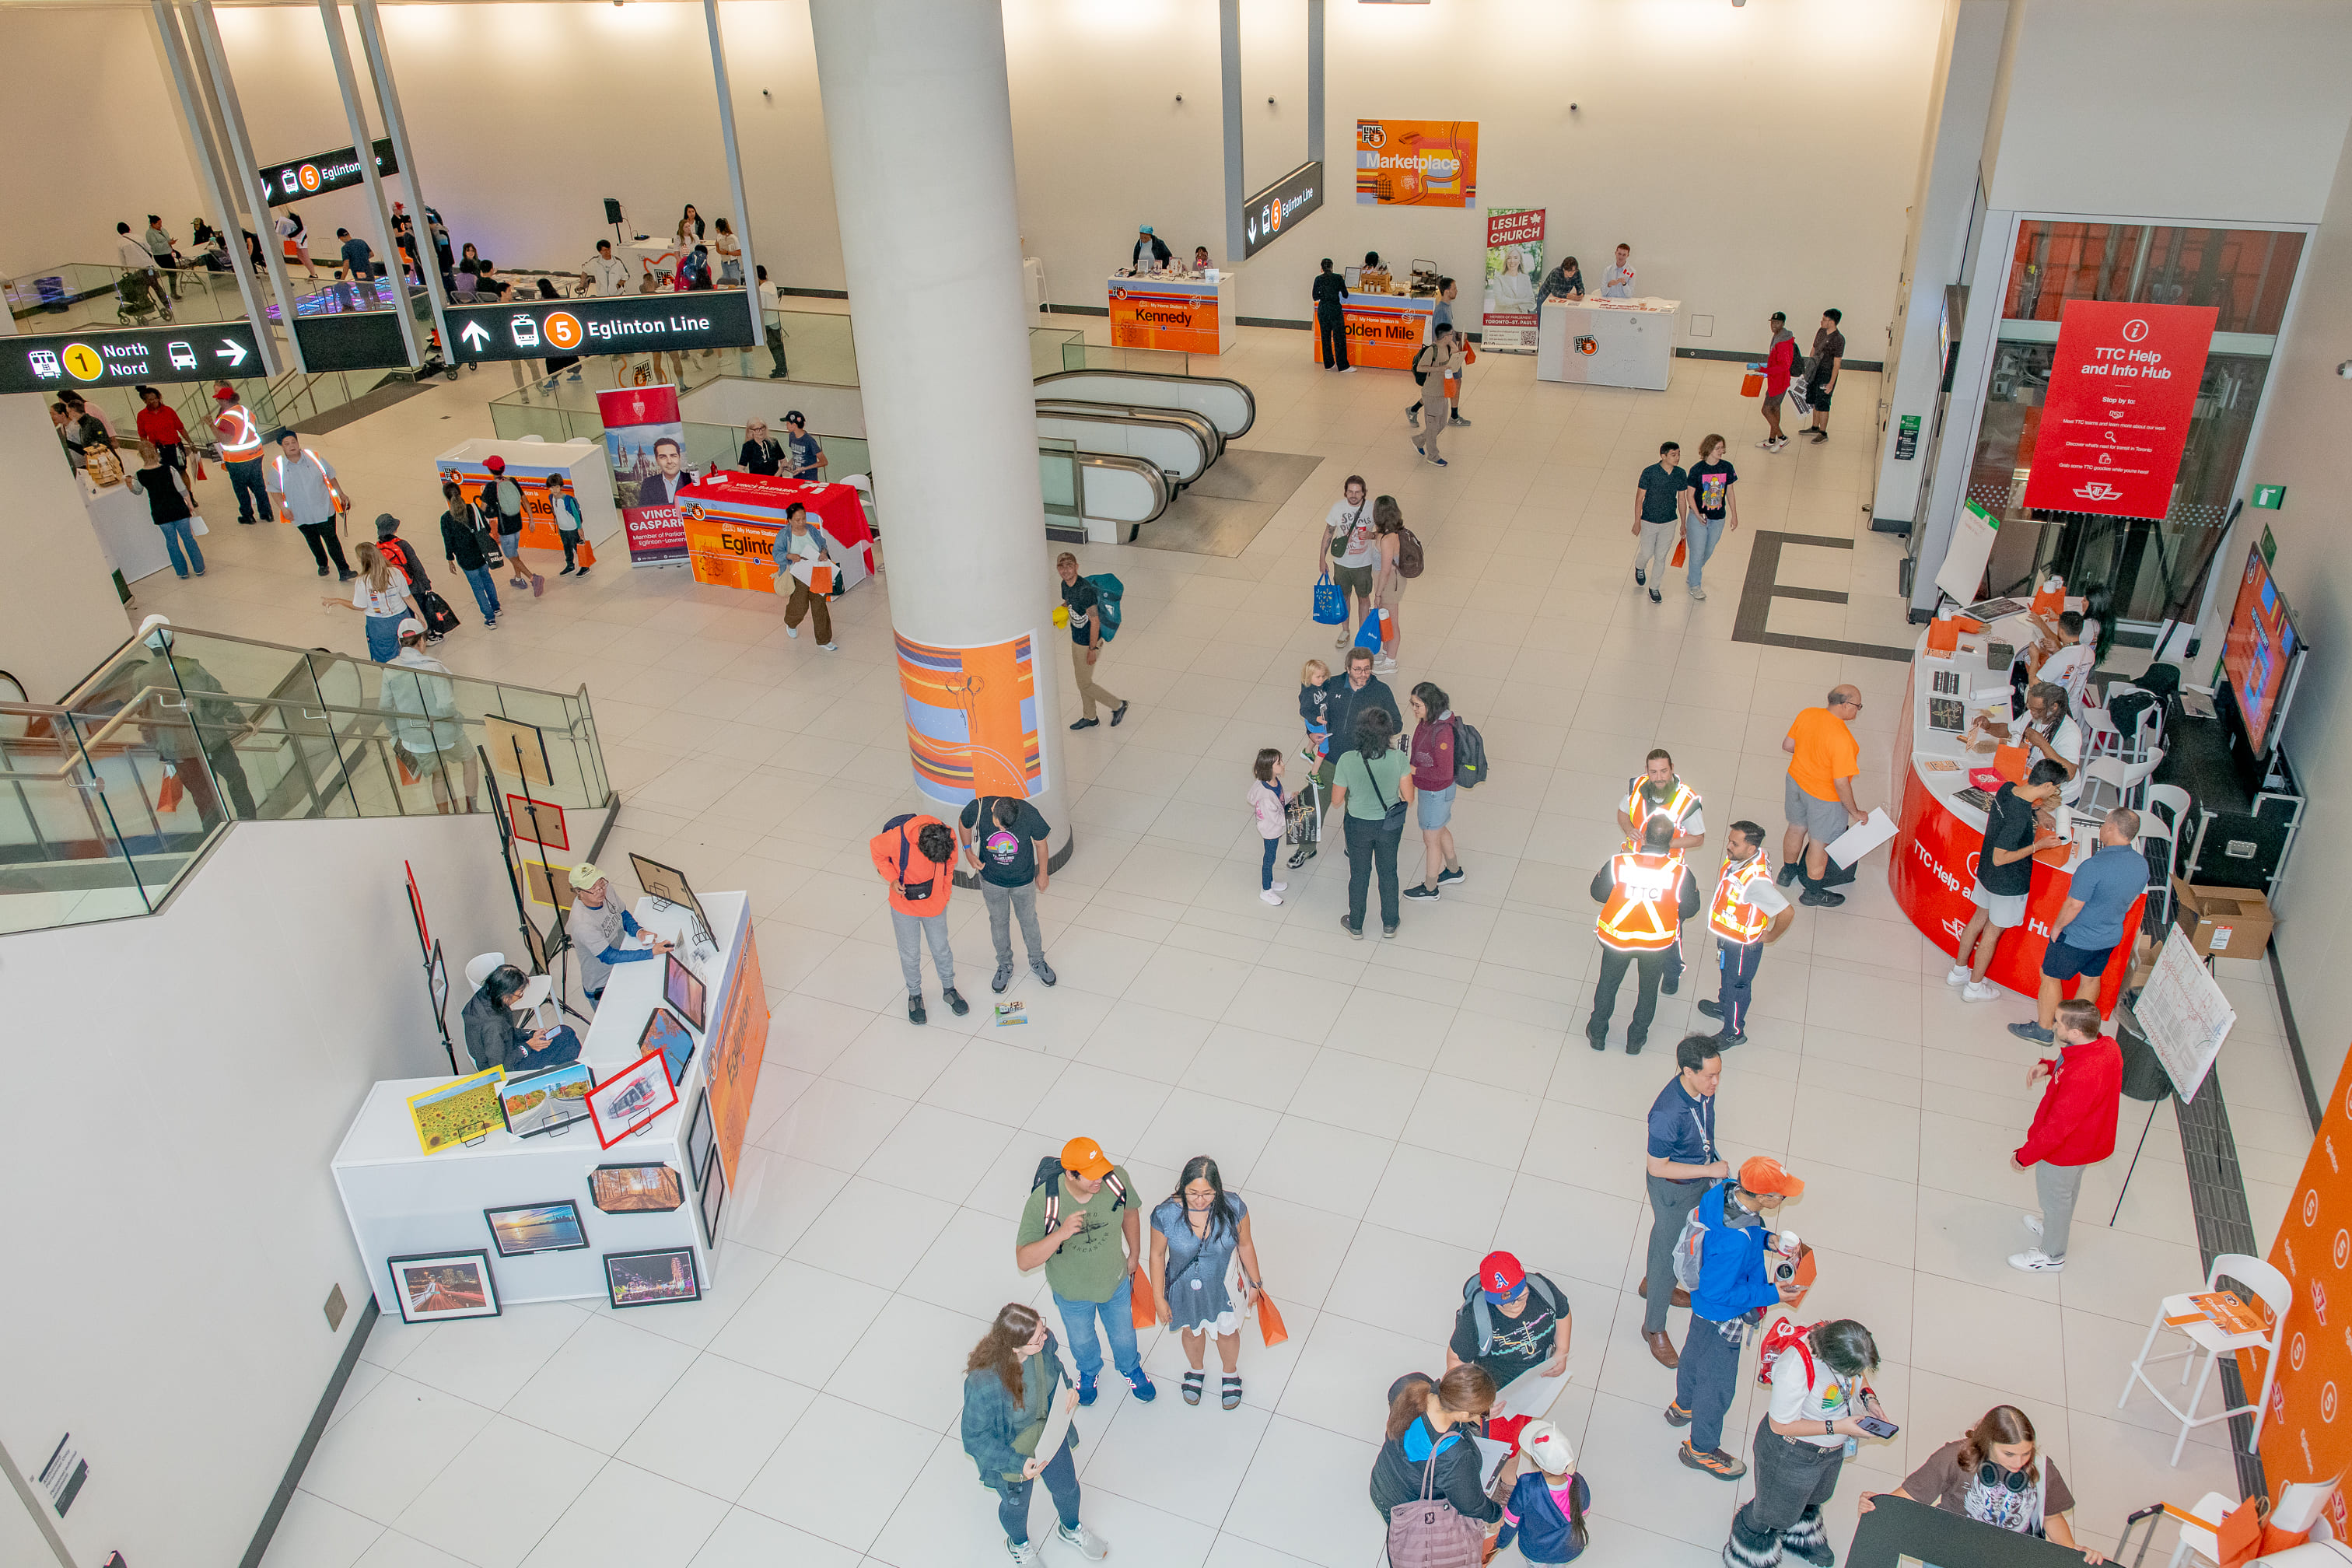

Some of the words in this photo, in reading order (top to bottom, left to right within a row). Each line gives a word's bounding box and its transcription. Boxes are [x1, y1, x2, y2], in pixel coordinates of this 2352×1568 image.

[1366, 152, 1460, 173] Marketplace
[304, 170, 315, 185] 5
[321, 162, 361, 181] Eglinton
[1274, 207, 1279, 224] 5
[1282, 194, 1302, 218] Eglinton
[1303, 187, 1313, 202] Line
[1492, 215, 1528, 230] LESLIE
[1490, 226, 1541, 243] CHURCH
[1136, 309, 1192, 327] Kennedy
[556, 321, 572, 341] 5
[587, 317, 669, 341] Eglinton
[671, 316, 710, 333] Line
[1344, 323, 1381, 338] olden
[1386, 325, 1414, 340] Mile
[75, 353, 89, 372] 1
[102, 342, 149, 359] North
[2095, 347, 2125, 361] TTC
[2128, 350, 2161, 365] Help
[108, 362, 149, 376] Nord
[2081, 363, 2109, 375] and
[2111, 364, 2138, 377] Info
[2141, 366, 2171, 380] Hub
[642, 508, 677, 520] VINCE
[1914, 838, 1933, 868] TTC
[1933, 860, 1960, 892] Help
[1629, 885, 1658, 899] TTC
[2028, 917, 2050, 938] Hu
[726, 993, 751, 1087] Eglinton
[2306, 1199, 2315, 1217] 5
[2337, 1239, 2347, 1258] 5
[1494, 1272, 1509, 1289] A
[2205, 1297, 2223, 1313] Crew
[2217, 1304, 2235, 1318] East
[2231, 1318, 2248, 1330] End
[2294, 1342, 2302, 1360] 5
[2324, 1391, 2334, 1412] 5
